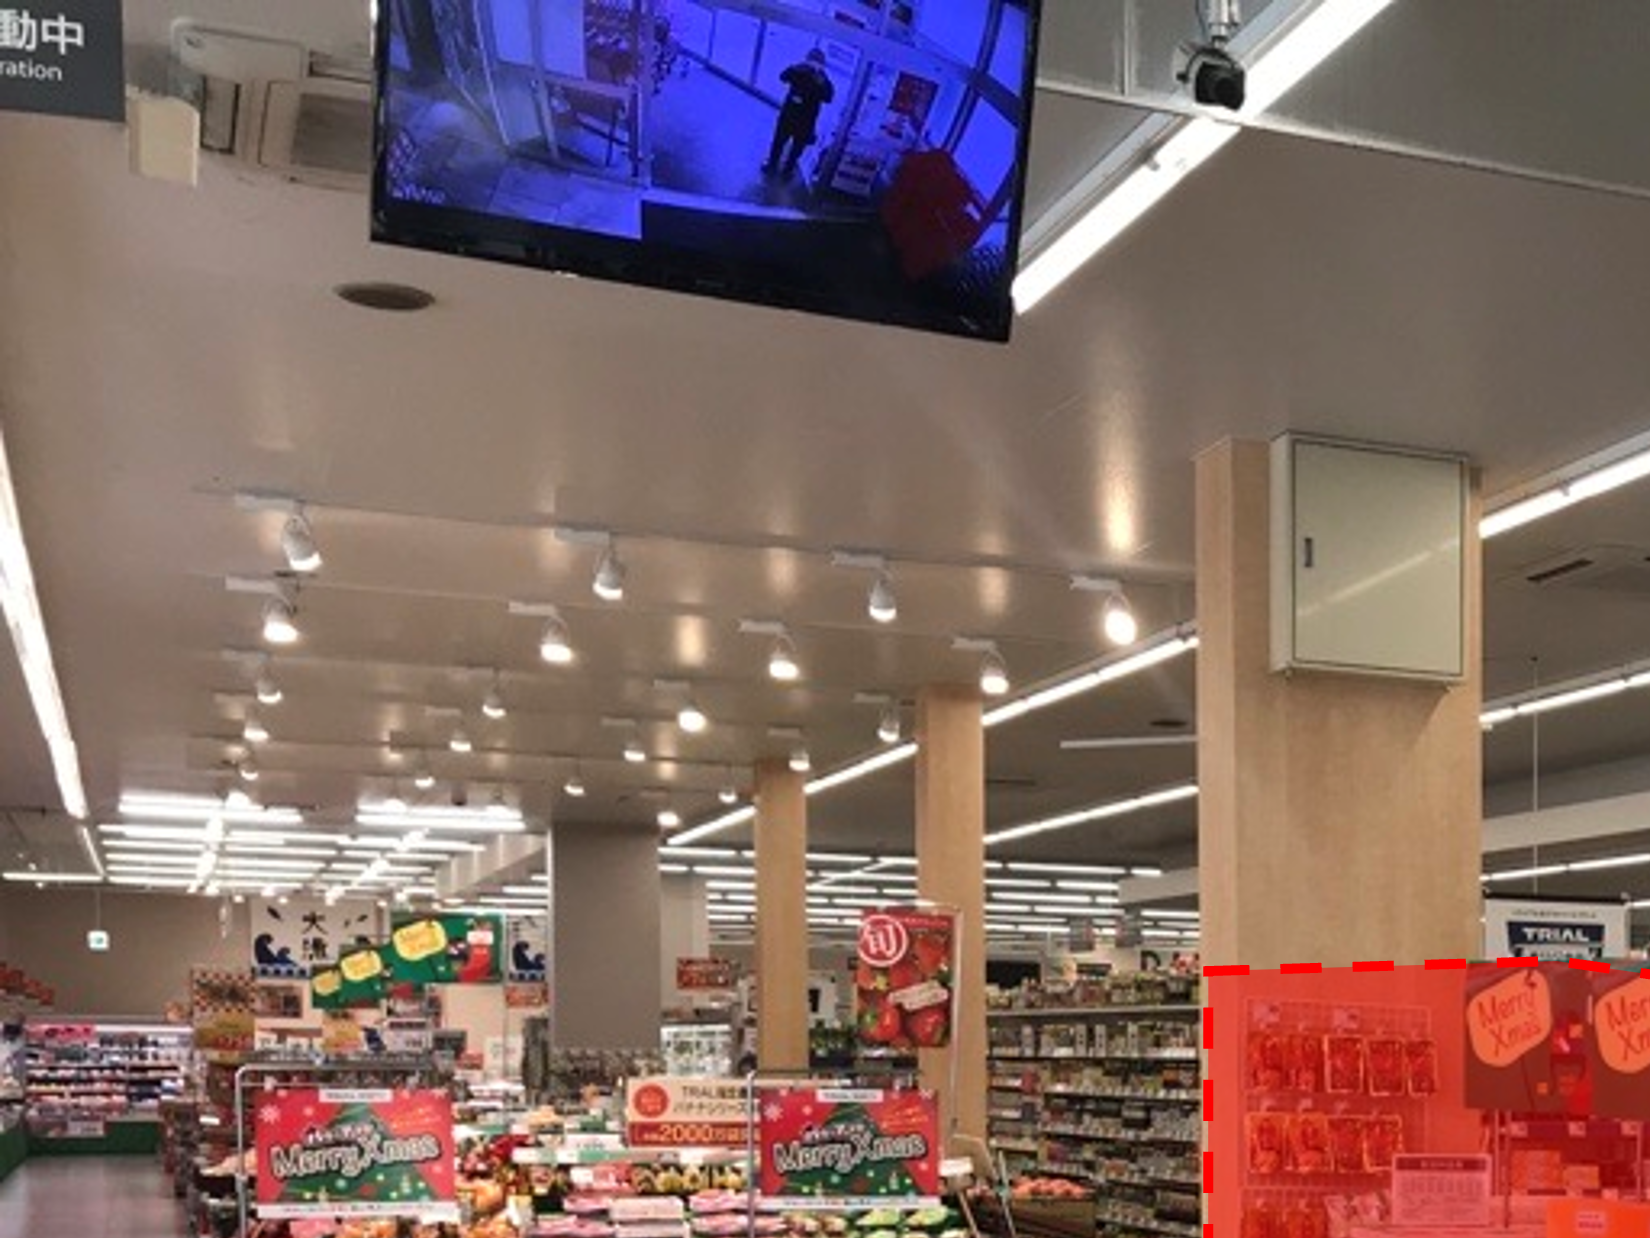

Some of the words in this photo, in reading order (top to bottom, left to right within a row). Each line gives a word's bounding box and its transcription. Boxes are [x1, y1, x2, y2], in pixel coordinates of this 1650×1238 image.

[1522, 926, 1590, 943] TRIAL
[1477, 986, 1531, 1028] Merry
[1489, 1018, 1542, 1057] Xmas
